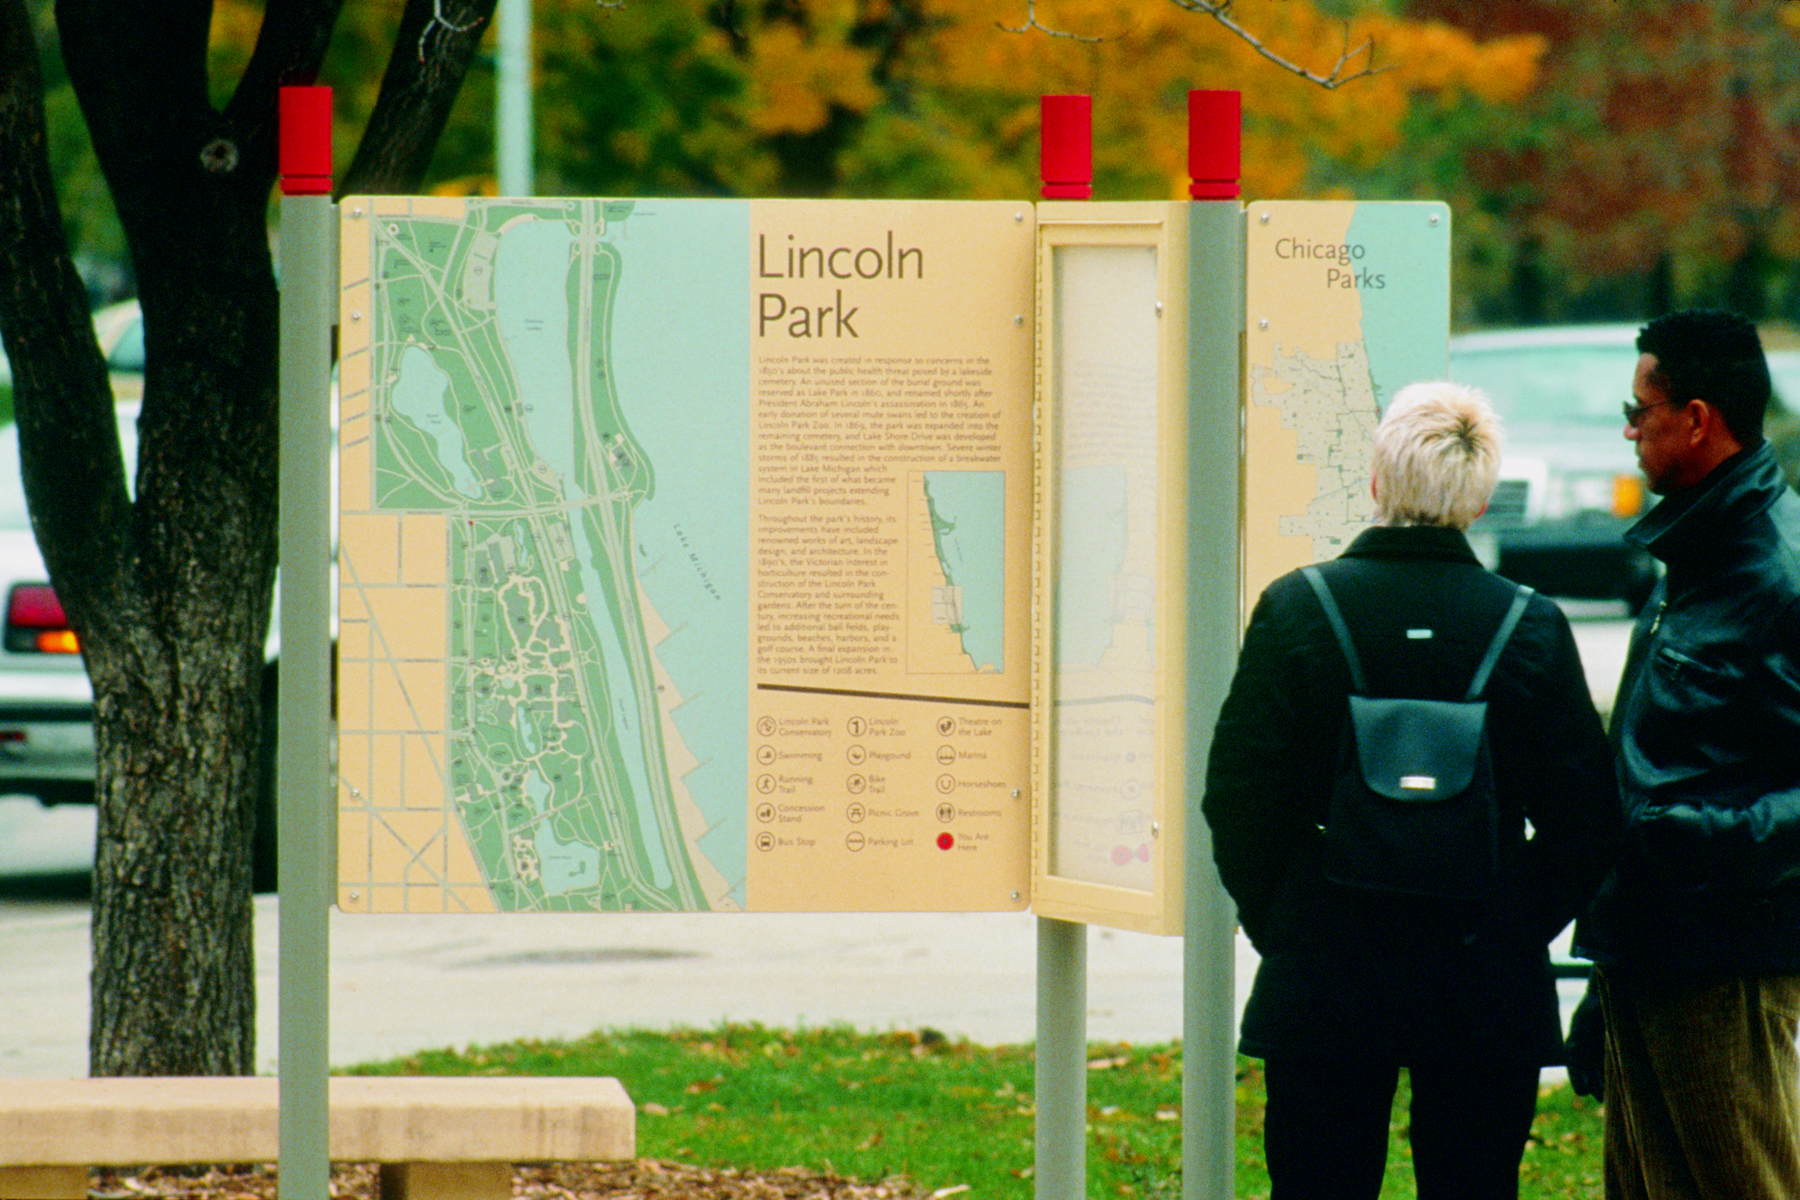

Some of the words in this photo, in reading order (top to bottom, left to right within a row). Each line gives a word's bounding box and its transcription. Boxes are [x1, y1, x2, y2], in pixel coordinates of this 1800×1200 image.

[759, 230, 923, 279] Lincoln
[1275, 236, 1365, 266] Chicago
[1327, 267, 1386, 289] Parks
[759, 289, 859, 338] Park
[759, 356, 789, 364] Lincoln
[792, 356, 810, 364] Park
[808, 388, 827, 397] Lake
[829, 388, 848, 397] Park
[759, 399, 797, 407] President
[800, 399, 838, 408] Abraham
[759, 421, 789, 429] Lincoln
[791, 421, 810, 429] Park
[863, 432, 882, 441] Lake
[885, 432, 909, 441] Shore
[911, 433, 934, 441] Drive
[800, 464, 819, 473] Lake
[822, 465, 861, 475] Michigan
[759, 497, 788, 505] Lincoln
[674, 524, 689, 547] Lake
[688, 553, 721, 600] Michigan
[824, 579, 854, 588] Lincoln
[857, 579, 876, 588] Park
[835, 655, 866, 664] Lincoln
[868, 655, 887, 664] Park
